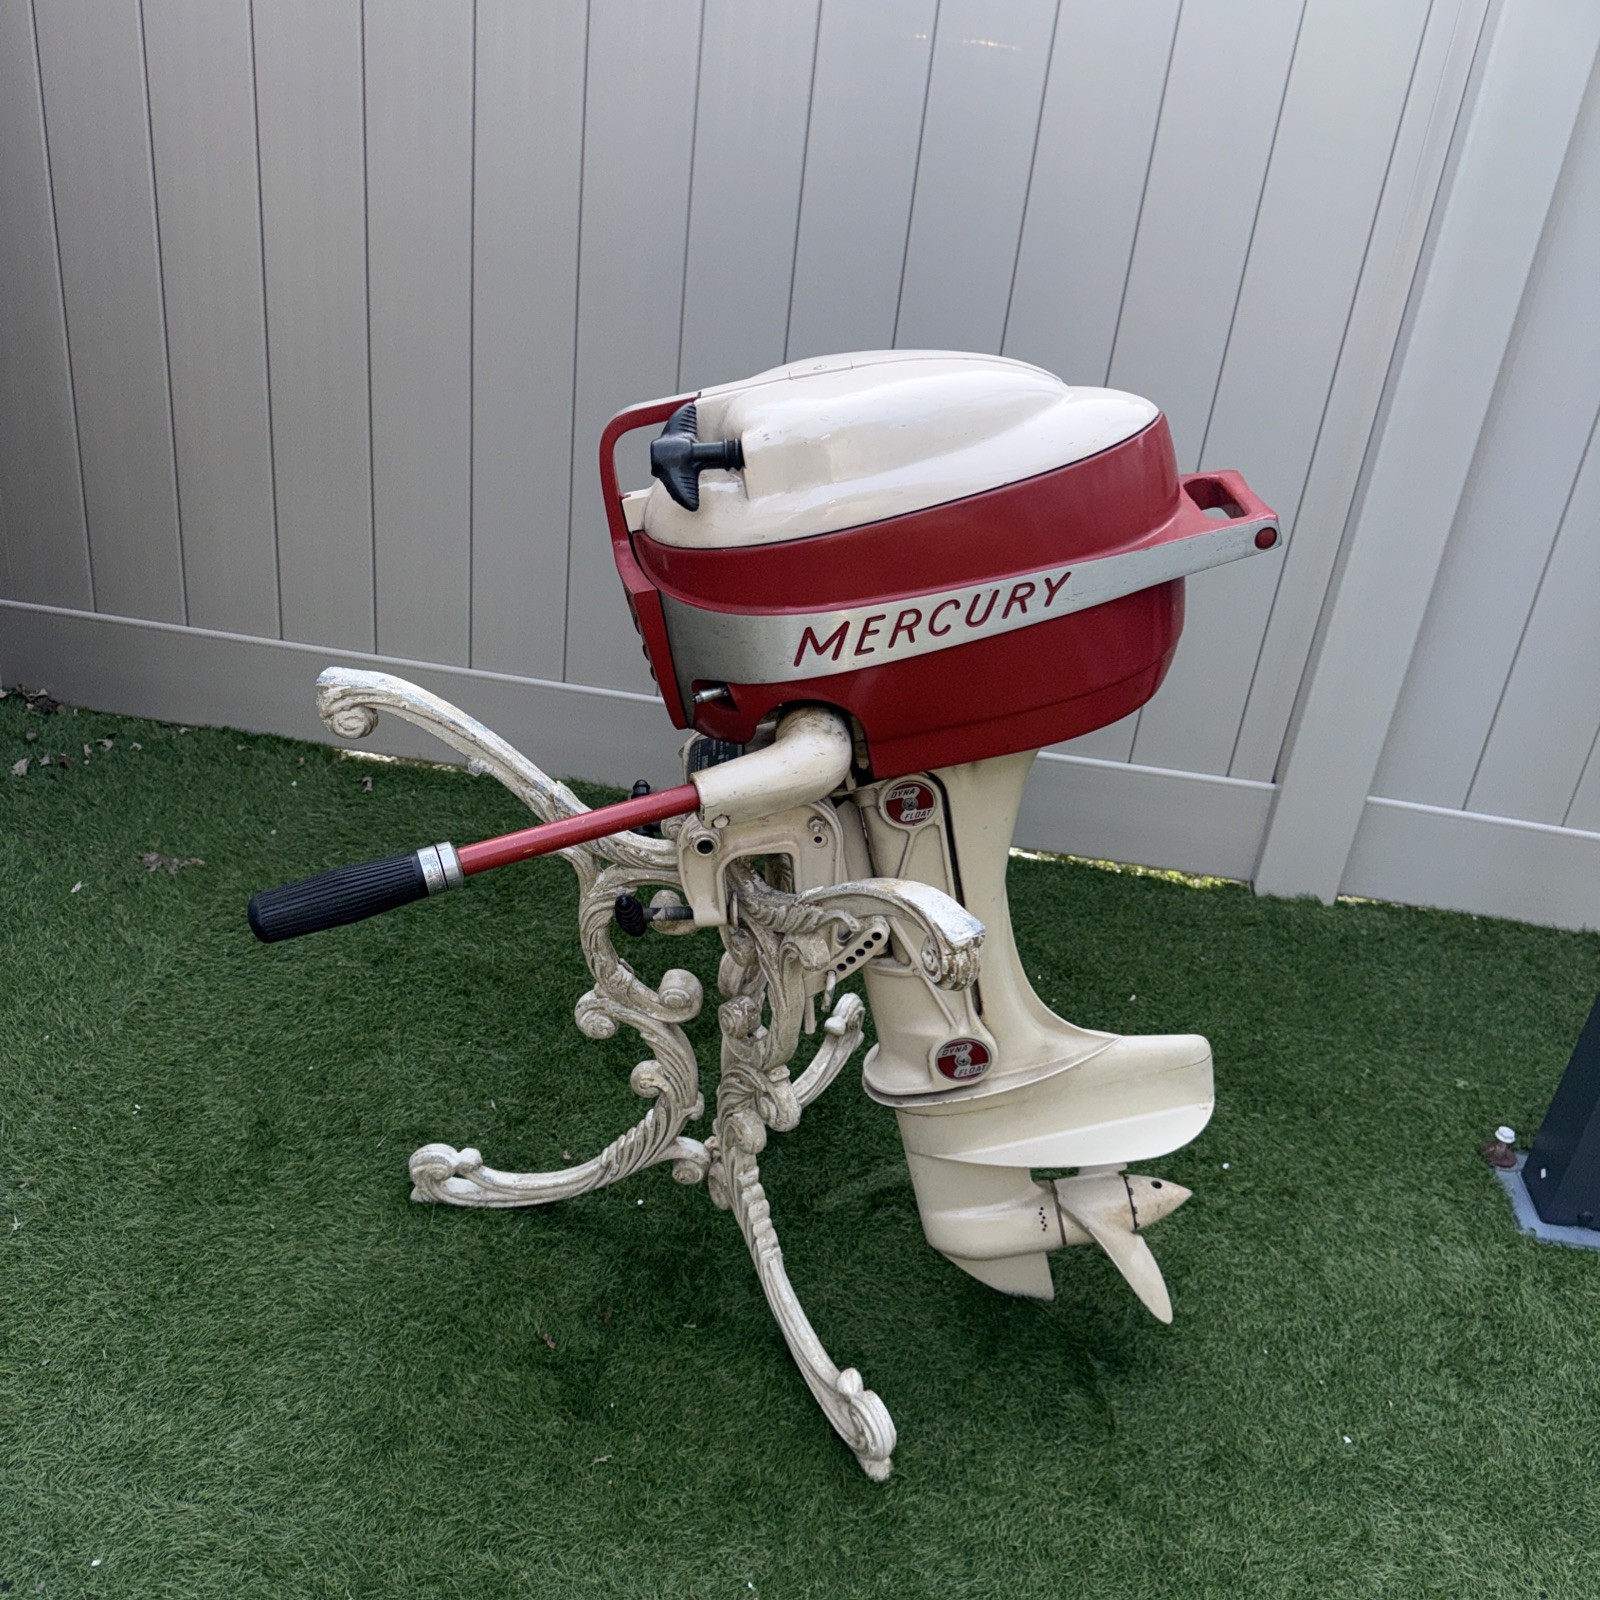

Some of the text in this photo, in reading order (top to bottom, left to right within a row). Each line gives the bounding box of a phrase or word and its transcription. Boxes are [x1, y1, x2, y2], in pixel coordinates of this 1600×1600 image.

[793, 571, 1072, 667] MERCURY
[890, 787, 916, 799] DYNA
[904, 809, 932, 820] FLOAT
[941, 1044, 968, 1056] DYNA
[957, 1064, 987, 1076] FLOAT
